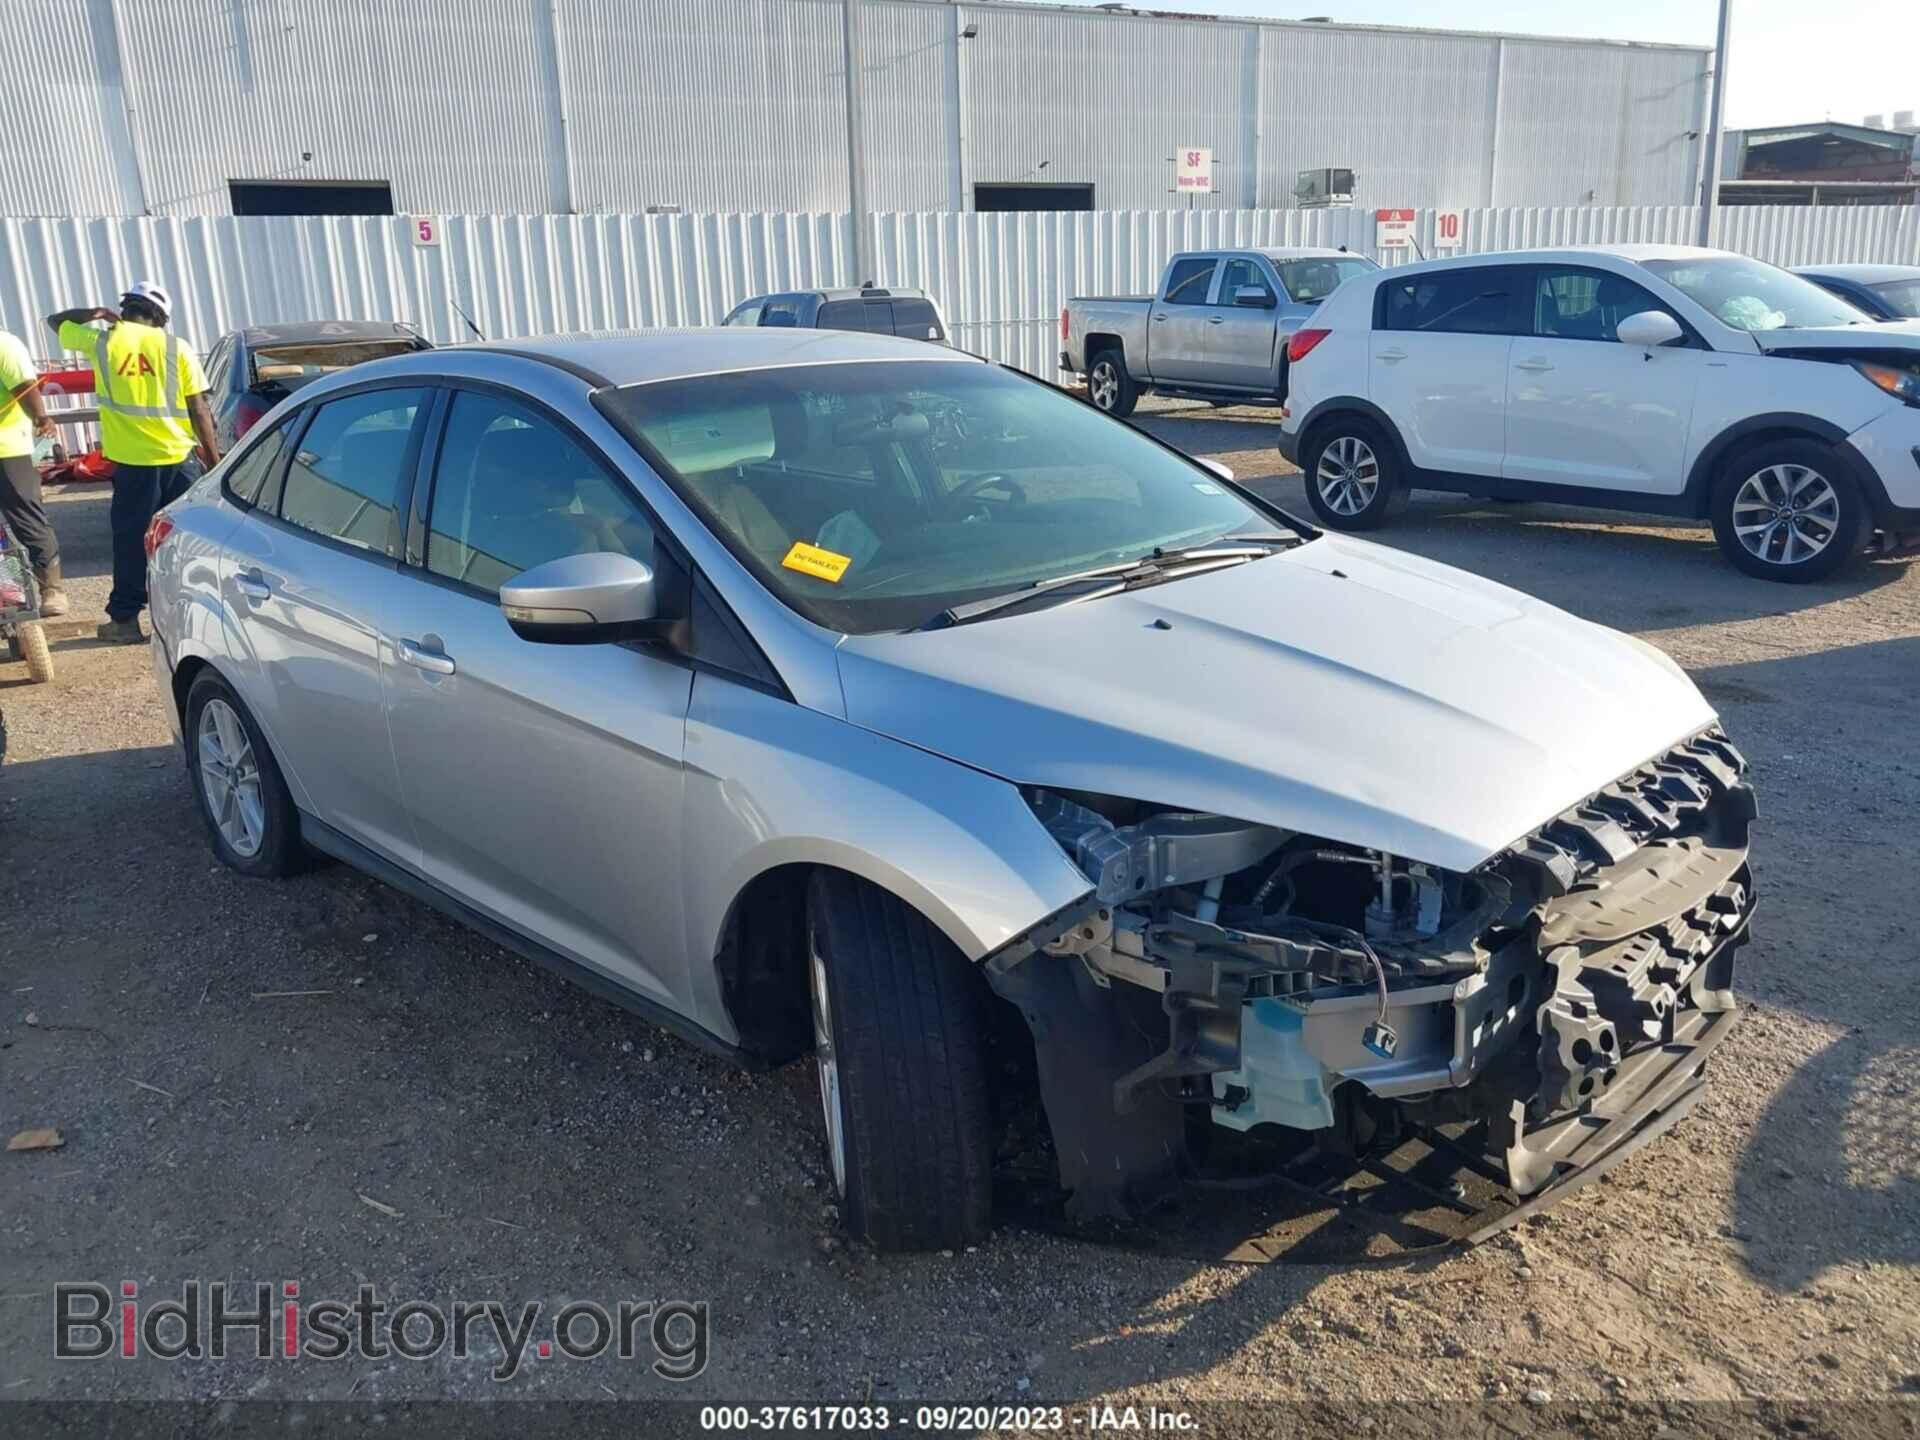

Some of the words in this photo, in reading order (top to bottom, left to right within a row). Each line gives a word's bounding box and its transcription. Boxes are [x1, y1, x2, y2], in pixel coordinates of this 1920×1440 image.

[1187, 152, 1201, 167] SF
[419, 221, 432, 241] 5
[1439, 214, 1458, 238] 10
